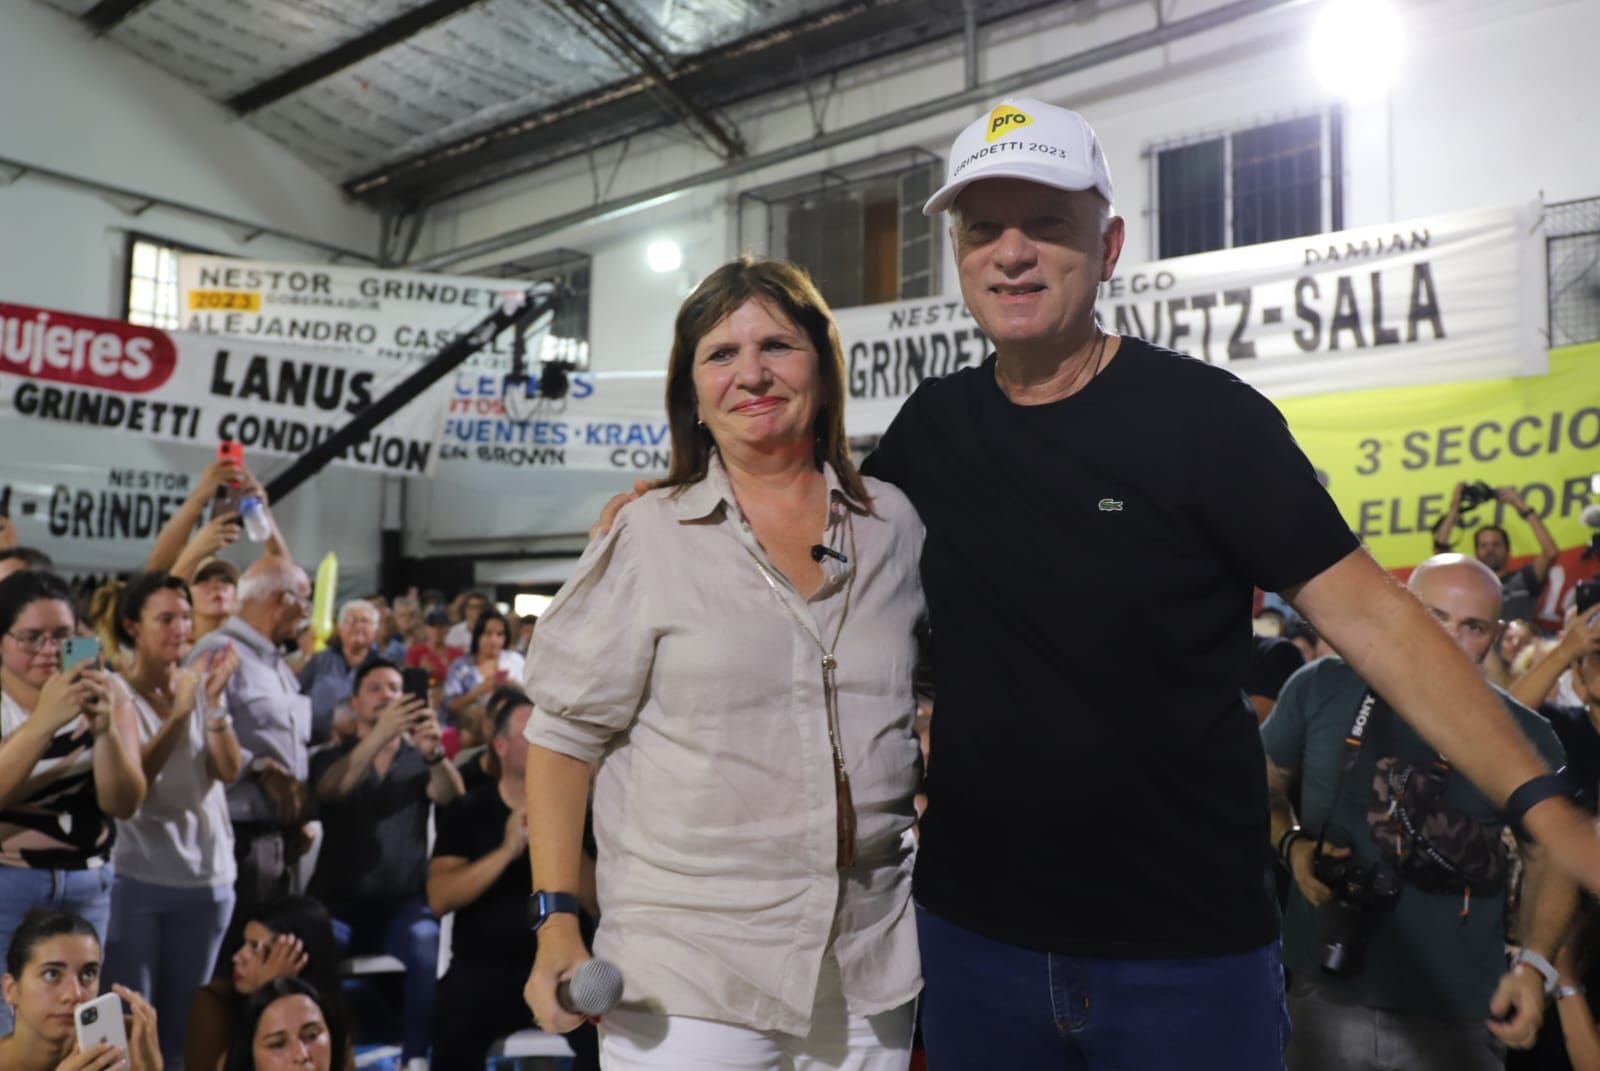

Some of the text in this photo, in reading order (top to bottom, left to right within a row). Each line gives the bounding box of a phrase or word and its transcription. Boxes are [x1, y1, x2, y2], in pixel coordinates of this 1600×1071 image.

[991, 112, 1026, 133] pro
[953, 141, 1067, 177] GRINDETTI 2023
[1304, 229, 1431, 265] DAMIAN
[200, 267, 333, 294] NESTOR
[195, 293, 252, 310] 2023
[0, 310, 154, 381] ujeres
[187, 312, 377, 345] ALEJANDRO
[210, 349, 374, 416] LANUS
[14, 381, 202, 438] GRINDETTI
[218, 413, 431, 473] CONDUCION
[477, 446, 566, 467] BROWN
[1402, 406, 1600, 471] SECCIO
[108, 468, 190, 490] NESTOR
[1351, 693, 1376, 737] SONY
